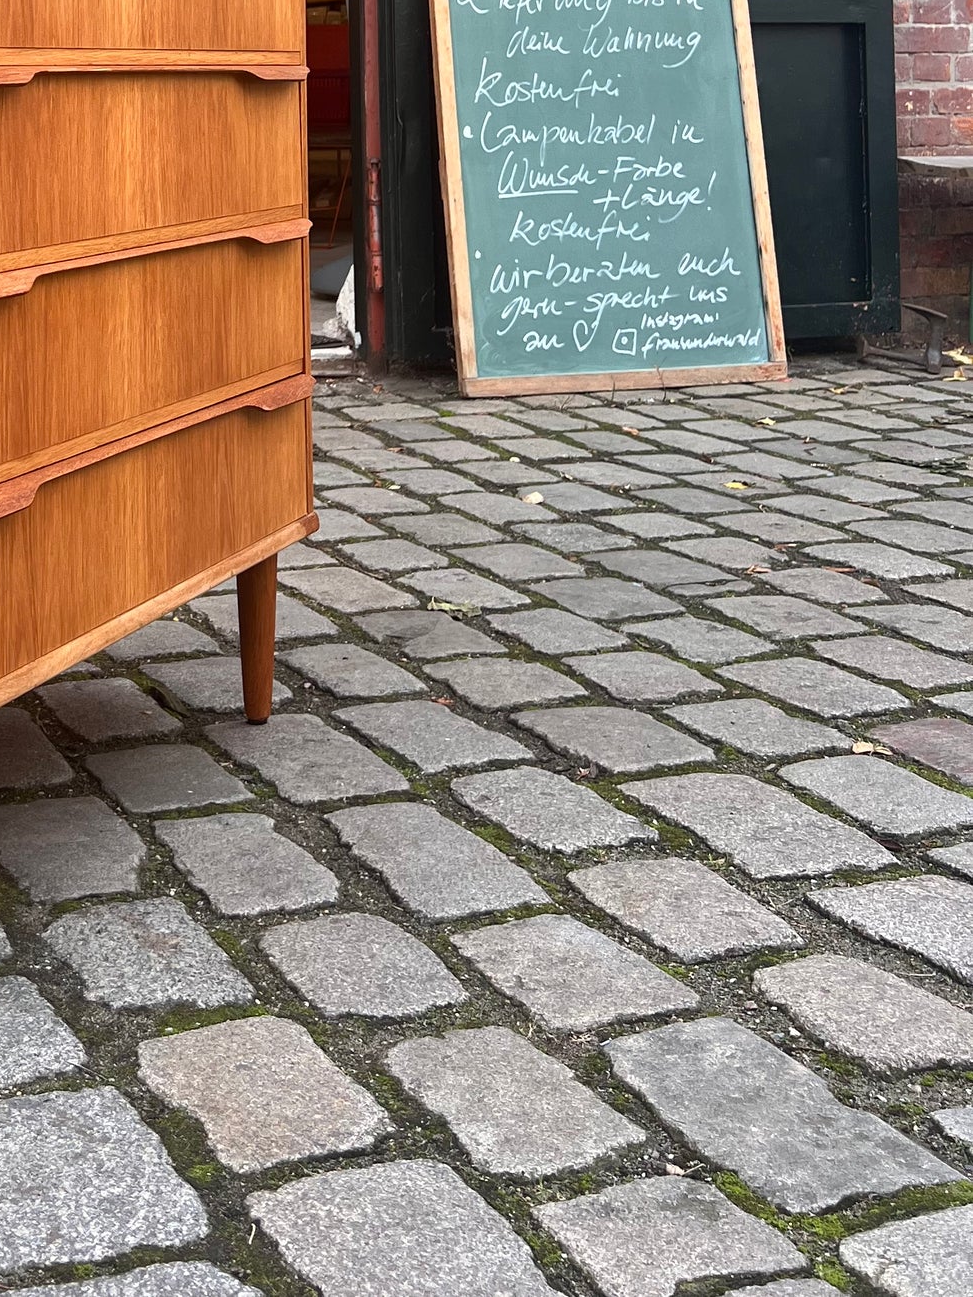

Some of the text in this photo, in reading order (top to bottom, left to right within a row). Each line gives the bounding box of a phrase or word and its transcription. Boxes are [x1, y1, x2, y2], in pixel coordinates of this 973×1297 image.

[506, 25, 571, 58] deine
[480, 111, 705, 167] Lampenkabel in
[678, 247, 741, 277] euch
[688, 285, 728, 303] uns
